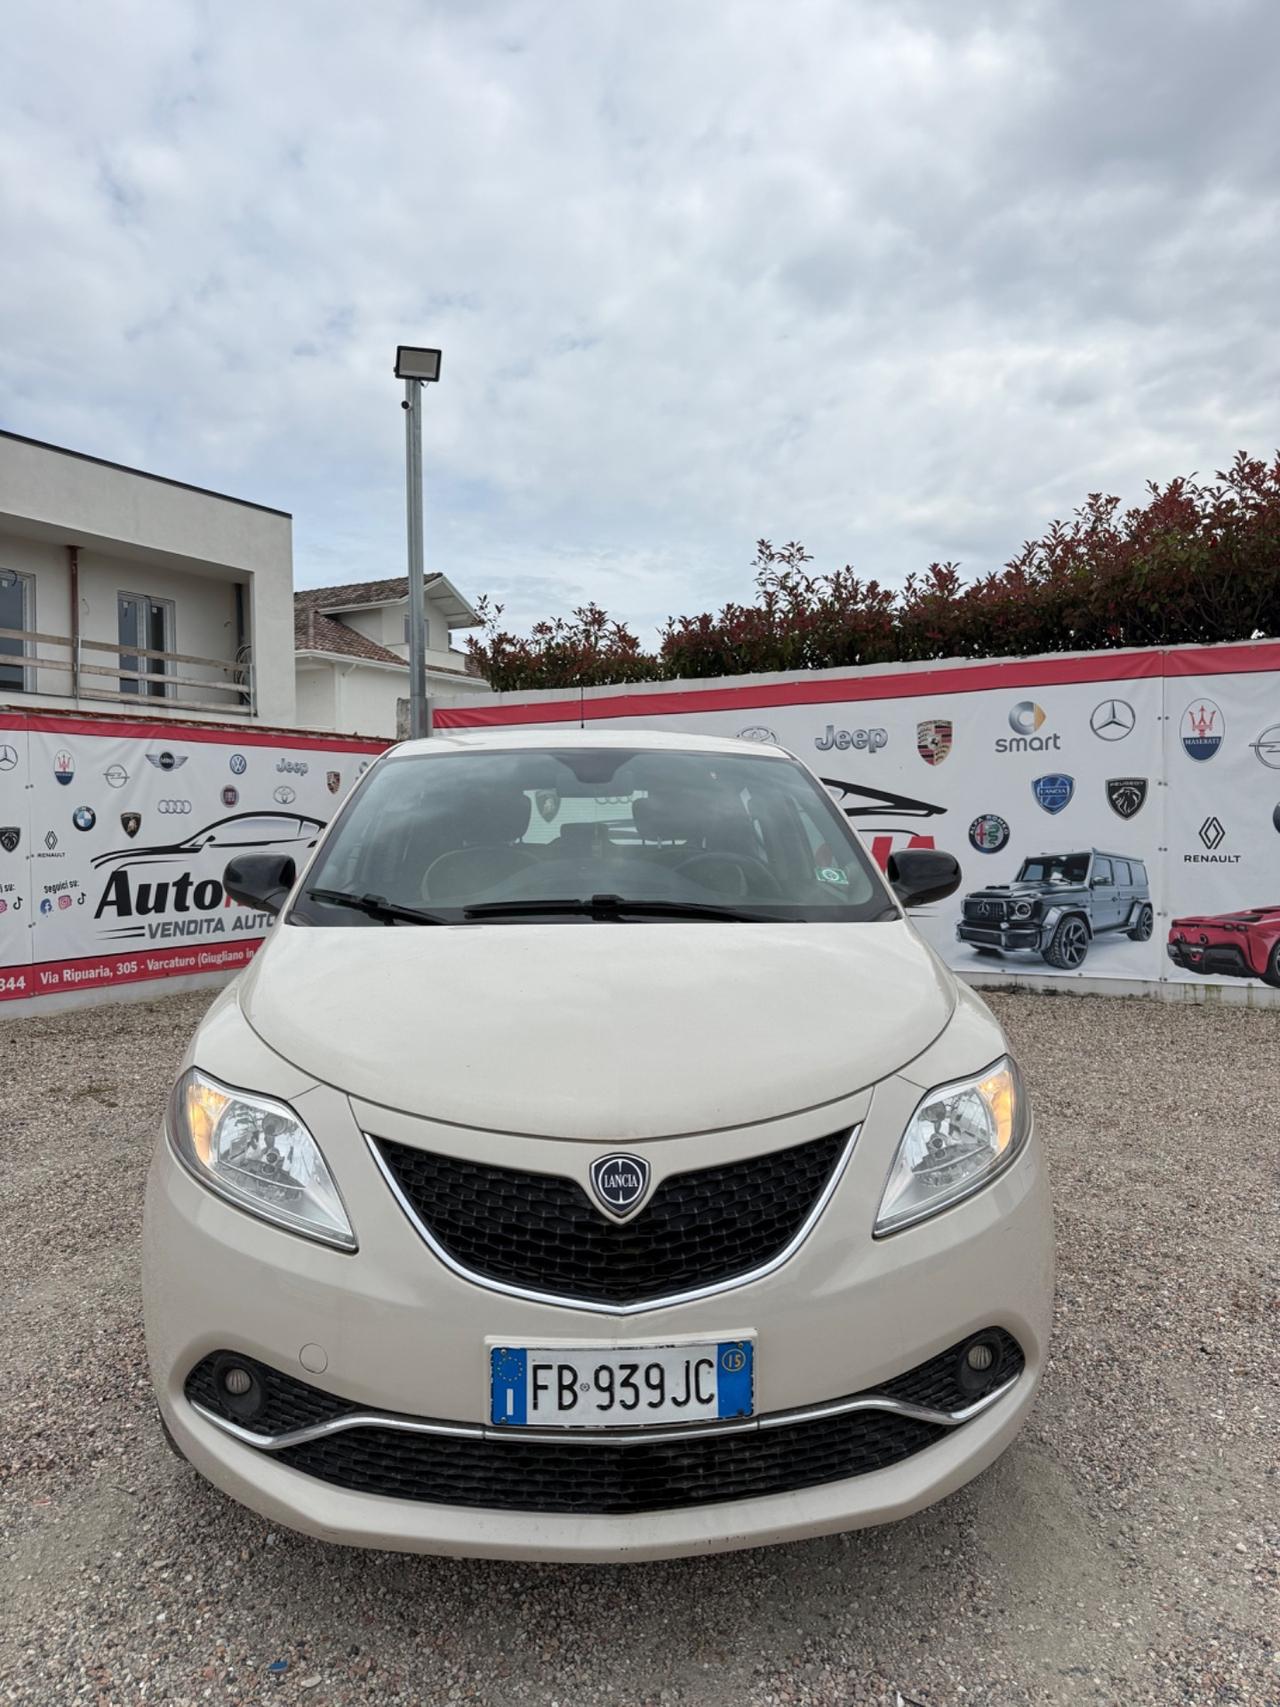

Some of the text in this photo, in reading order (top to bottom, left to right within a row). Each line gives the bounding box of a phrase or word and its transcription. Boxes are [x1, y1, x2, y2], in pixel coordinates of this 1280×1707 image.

[815, 724, 888, 753] Jeep
[995, 733, 1061, 753] smart
[1185, 737, 1221, 745] MASERATI
[276, 758, 309, 776] Jeep
[1184, 855, 1241, 863] RENAULT
[147, 916, 225, 939] VENDITA
[40, 971, 59, 985] Via
[63, 965, 113, 983] Ripuaria,
[116, 961, 137, 975] 305
[147, 953, 195, 971] Varcaturo
[198, 949, 244, 968] (Giugliano
[604, 1174, 639, 1188] LANCIA
[532, 1364, 578, 1411] FB
